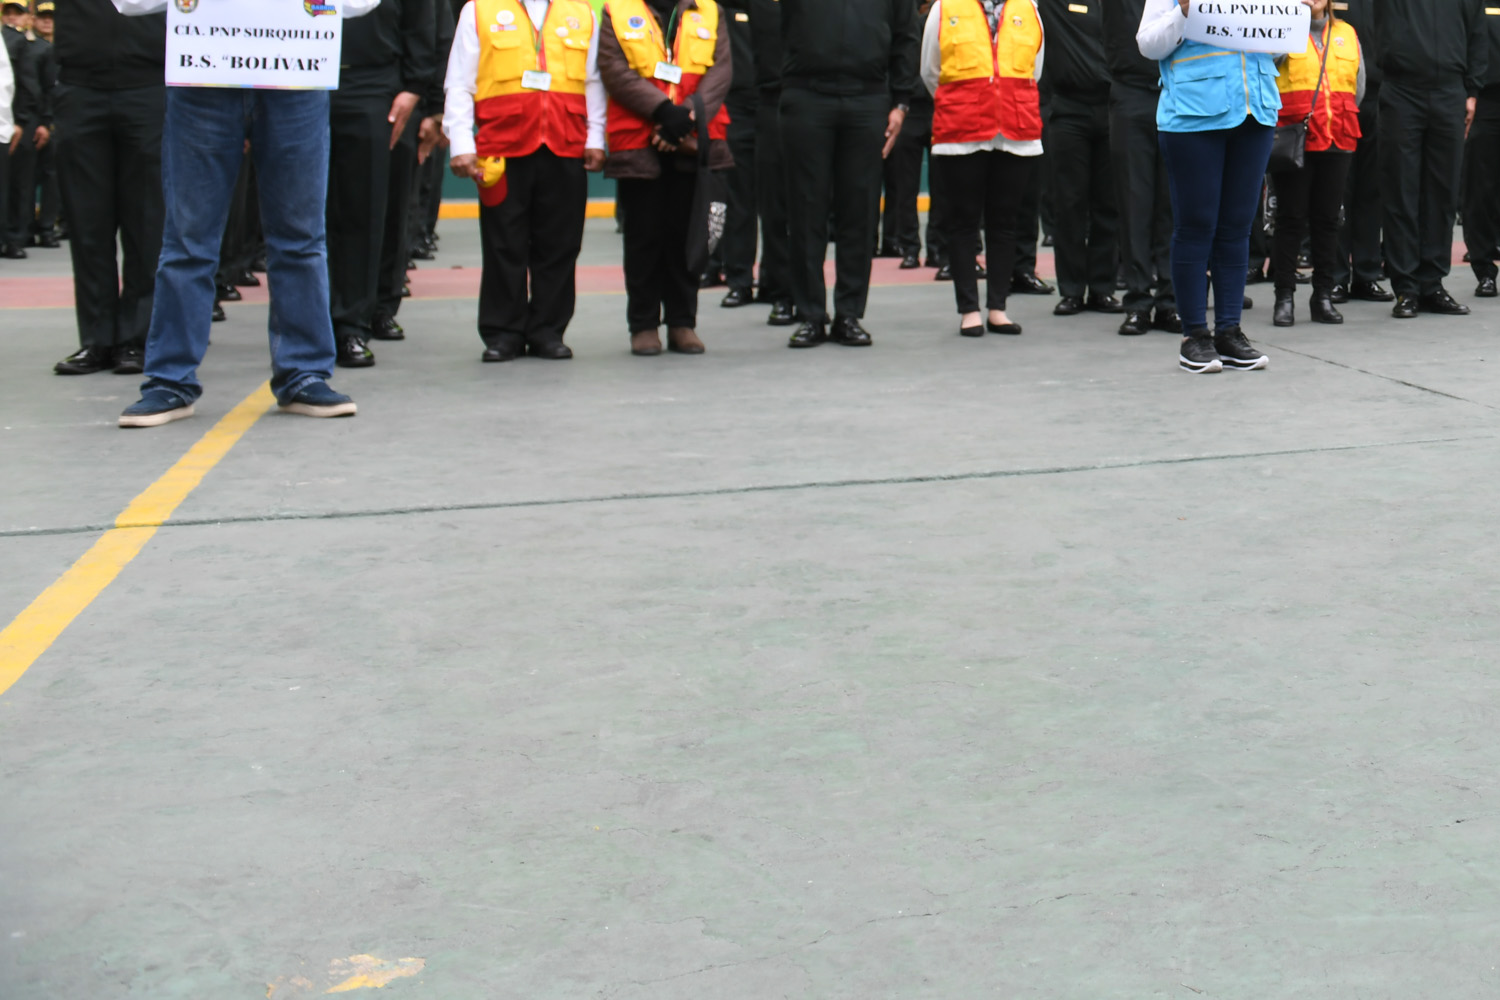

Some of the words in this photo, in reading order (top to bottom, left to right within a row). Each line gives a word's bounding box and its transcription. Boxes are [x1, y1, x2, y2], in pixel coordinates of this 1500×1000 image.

[1198, 0, 1227, 15] CÍA.
[1230, 3, 1258, 16] PNP
[1262, 5, 1303, 16] LINCE
[174, 22, 205, 37] CÍA.
[210, 25, 241, 38] PNP
[243, 28, 335, 42] SURQUILLO
[1205, 25, 1233, 38] B.S.
[179, 54, 216, 69] B.S.
